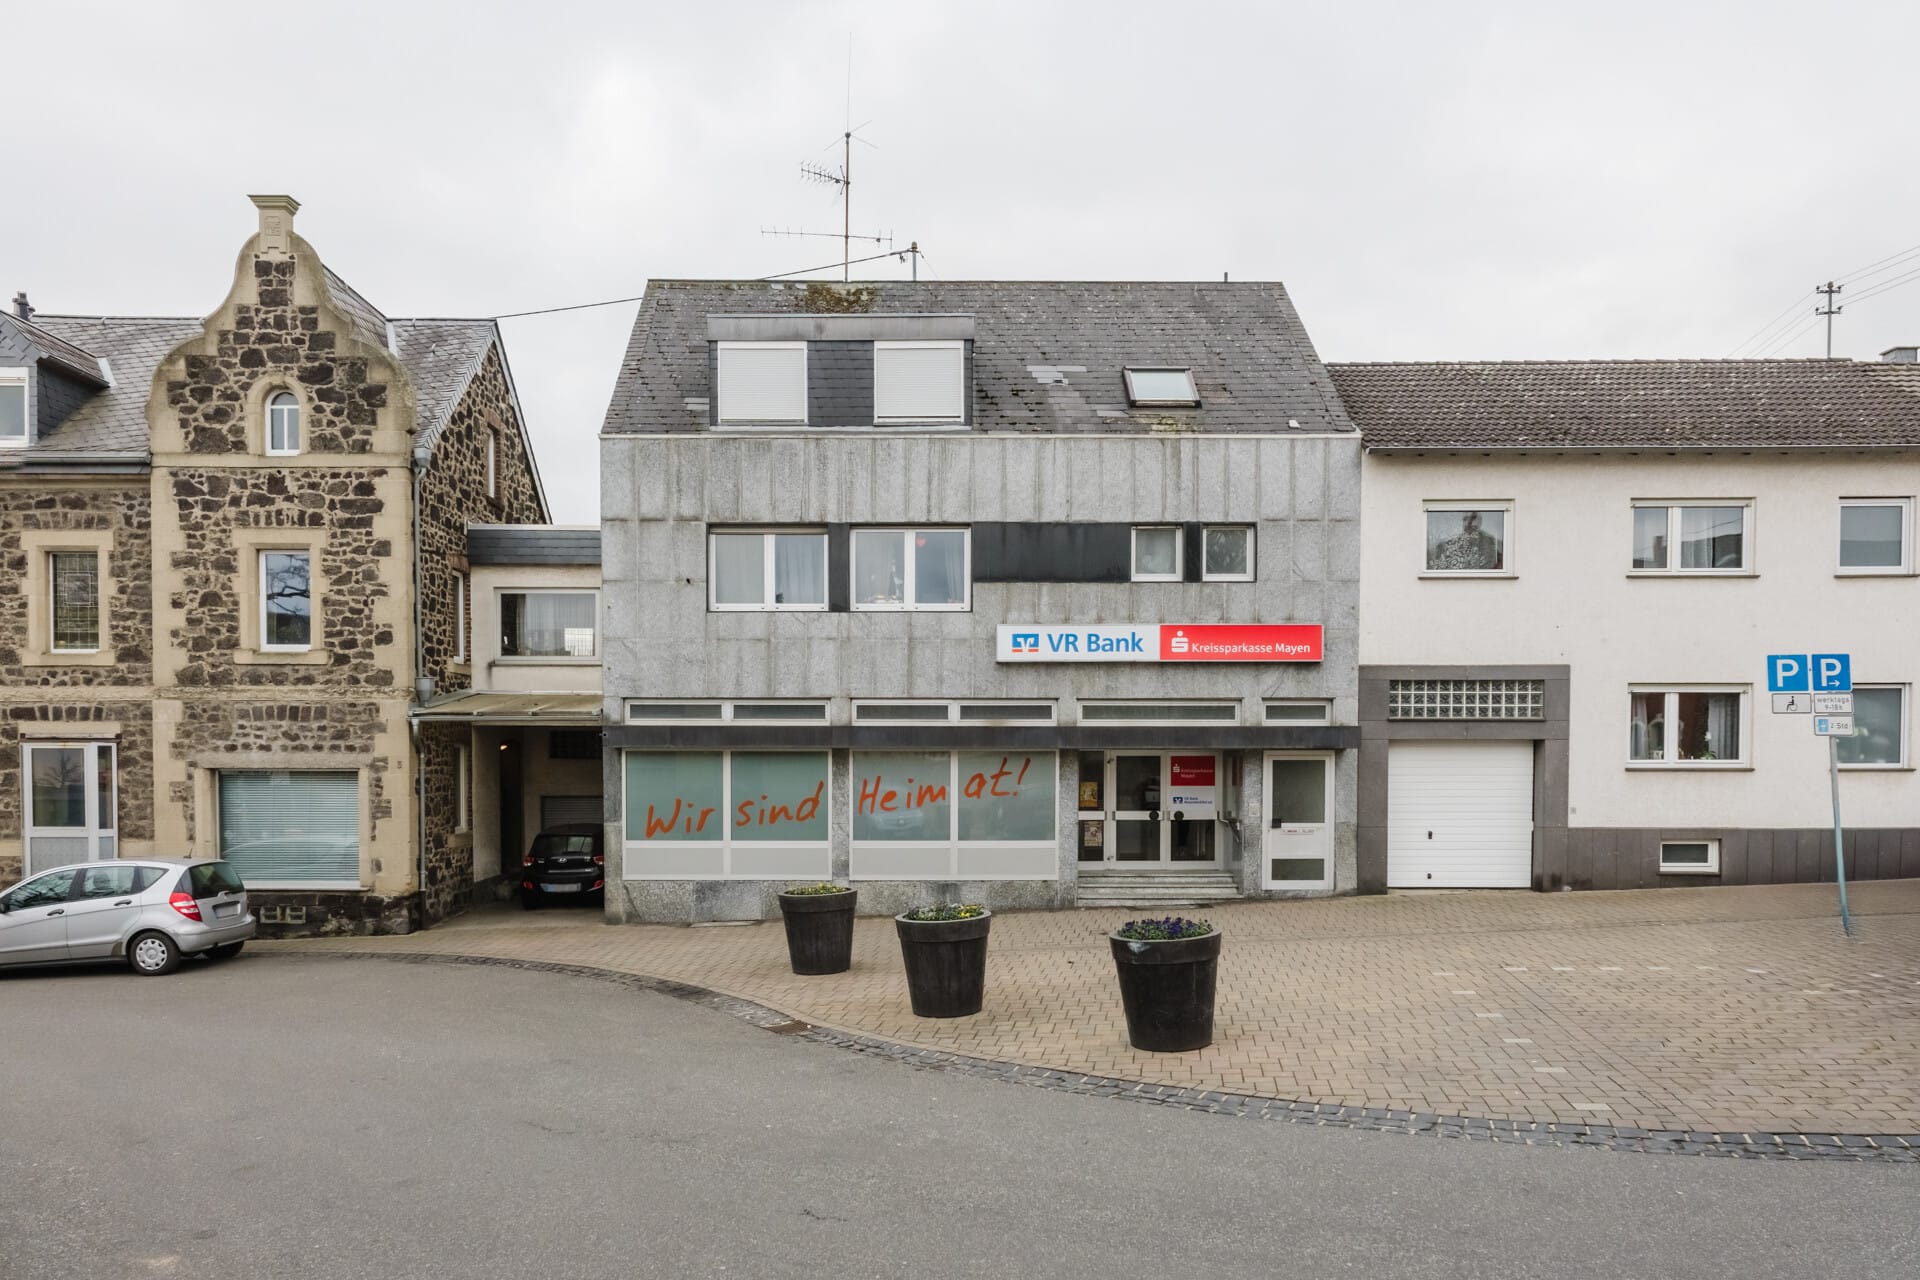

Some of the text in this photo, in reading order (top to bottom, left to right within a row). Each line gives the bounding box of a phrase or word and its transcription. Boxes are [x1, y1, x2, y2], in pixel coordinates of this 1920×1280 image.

[1047, 632, 1143, 652] VR Bank
[1192, 643, 1272, 655] Kreissparkasse
[1276, 643, 1310, 655] Mayen
[1776, 659, 1799, 687] P
[1820, 658, 1841, 687] P
[645, 797, 715, 838] Wir
[736, 780, 824, 827] sind
